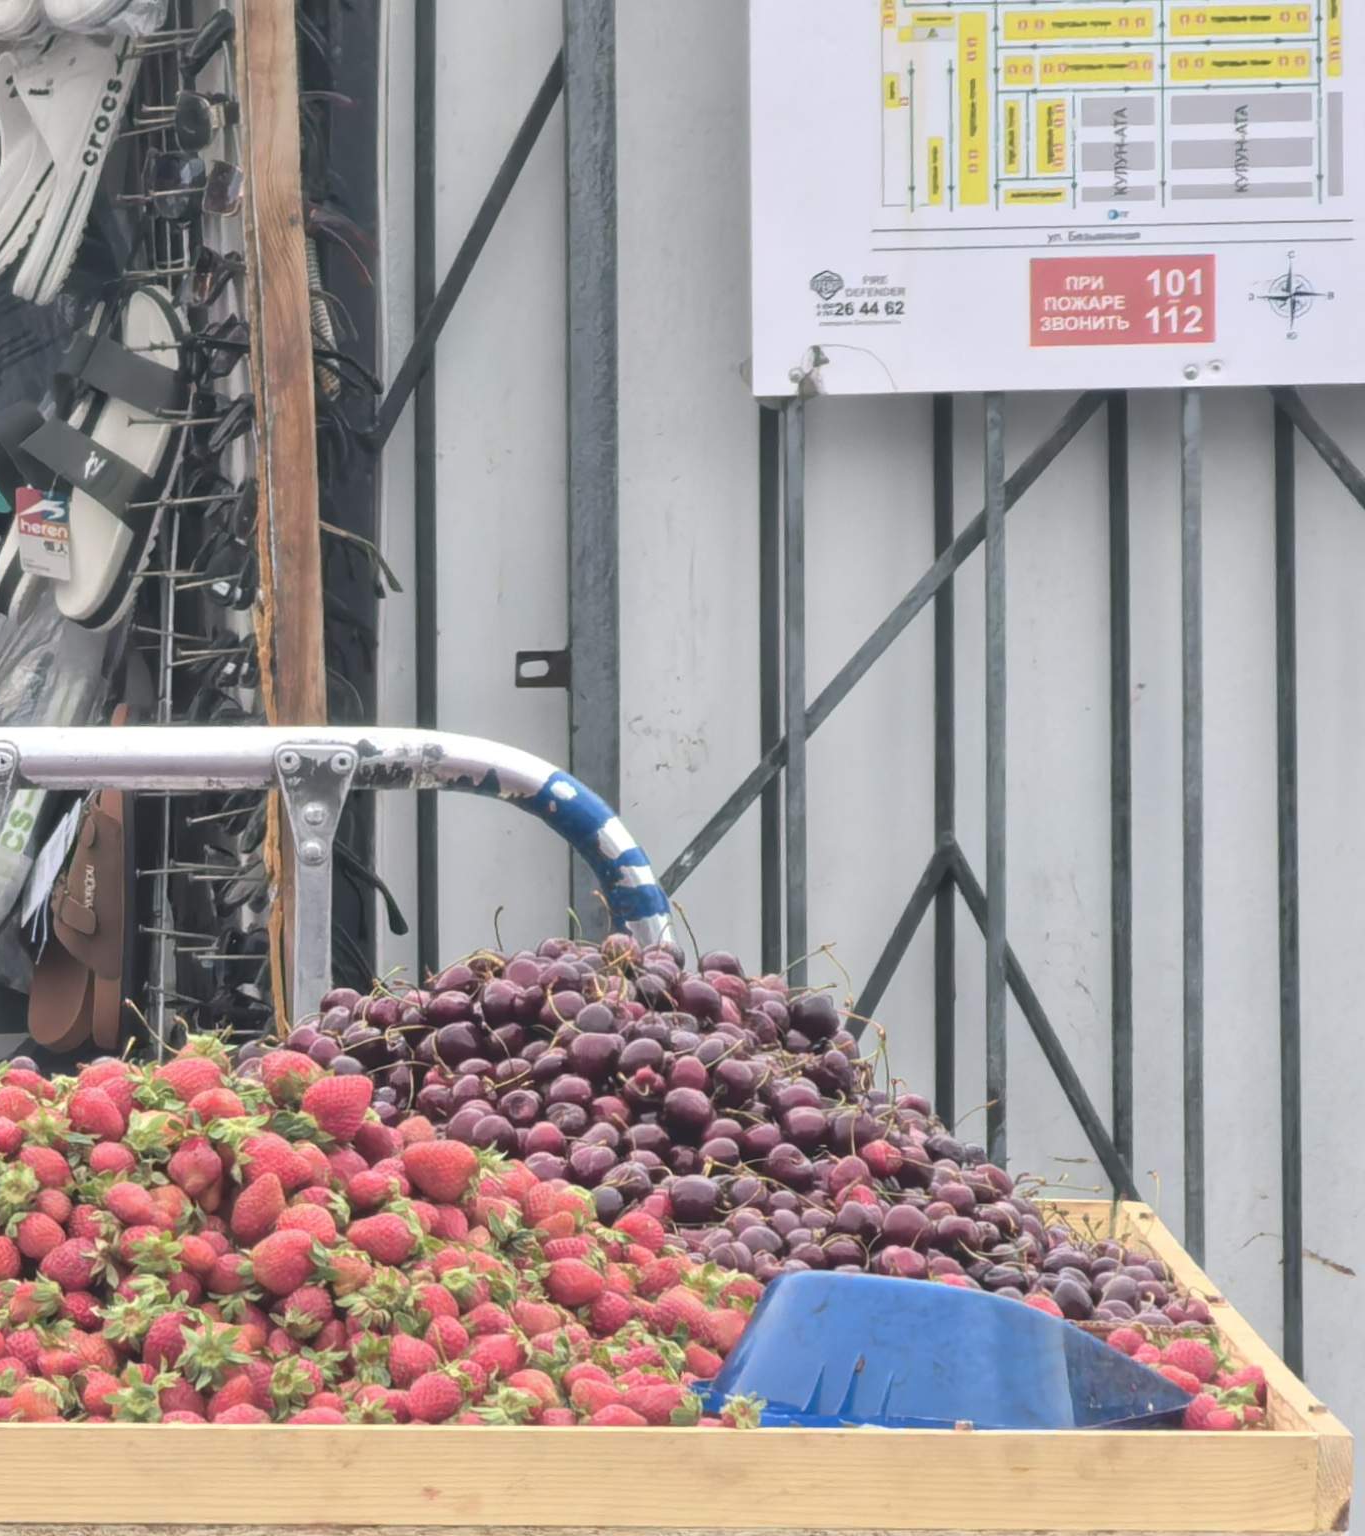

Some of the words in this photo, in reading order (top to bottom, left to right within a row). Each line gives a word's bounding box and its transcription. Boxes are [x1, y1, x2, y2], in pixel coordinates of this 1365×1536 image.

[82, 79, 123, 167] crocs
[1065, 275, 1105, 291] ПРИ
[1146, 268, 1204, 297] 101
[835, 302, 854, 316] 26
[859, 302, 879, 315] 44
[884, 301, 905, 315] 62
[1043, 295, 1126, 312] ПОЖАРЕ
[1039, 315, 1130, 332] ЗВОНИТЬ
[1144, 305, 1204, 334] 112
[19, 518, 69, 539] heren
